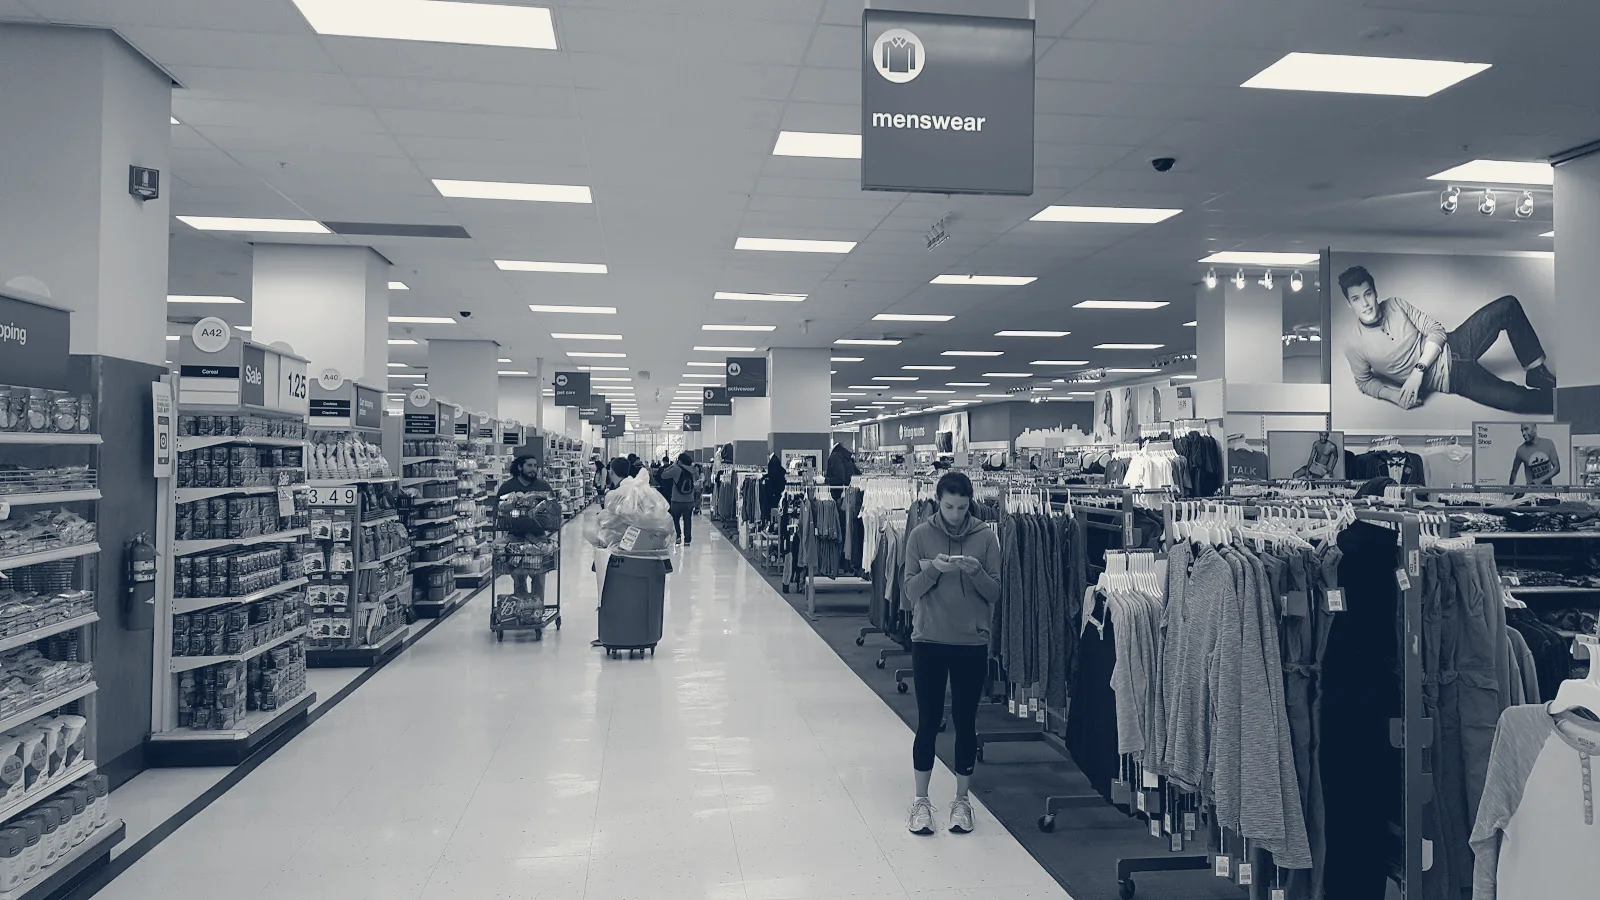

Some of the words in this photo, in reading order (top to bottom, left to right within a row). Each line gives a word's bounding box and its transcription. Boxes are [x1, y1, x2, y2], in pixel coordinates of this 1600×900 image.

[872, 112, 986, 132] menswear
[201, 328, 222, 337] A42
[245, 364, 262, 385] Sale
[288, 371, 306, 399] 1.25
[1231, 465, 1257, 476] TALK
